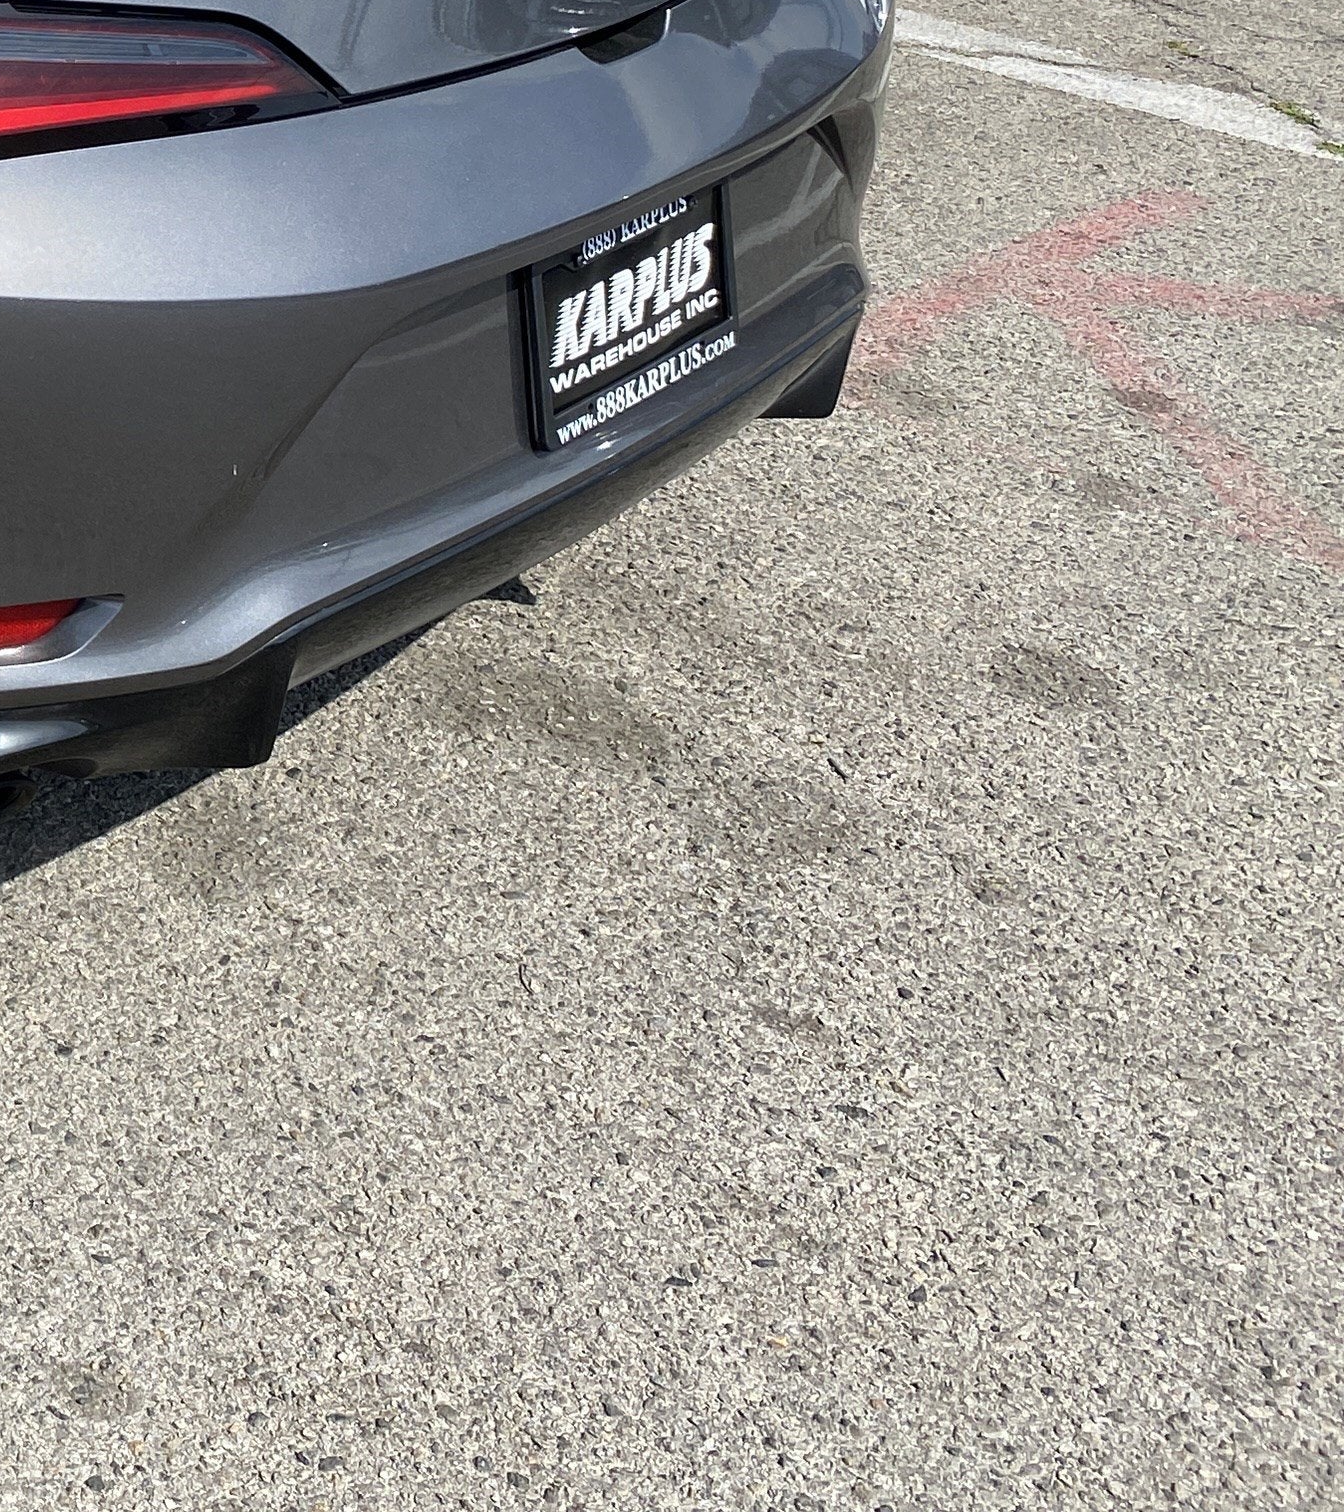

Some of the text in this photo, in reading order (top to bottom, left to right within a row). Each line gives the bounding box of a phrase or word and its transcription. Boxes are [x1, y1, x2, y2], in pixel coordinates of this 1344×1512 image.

[582, 196, 688, 260] (888) KARPLUS
[548, 221, 717, 369] KARPLUS
[548, 288, 721, 394] WAREHOUSE INC
